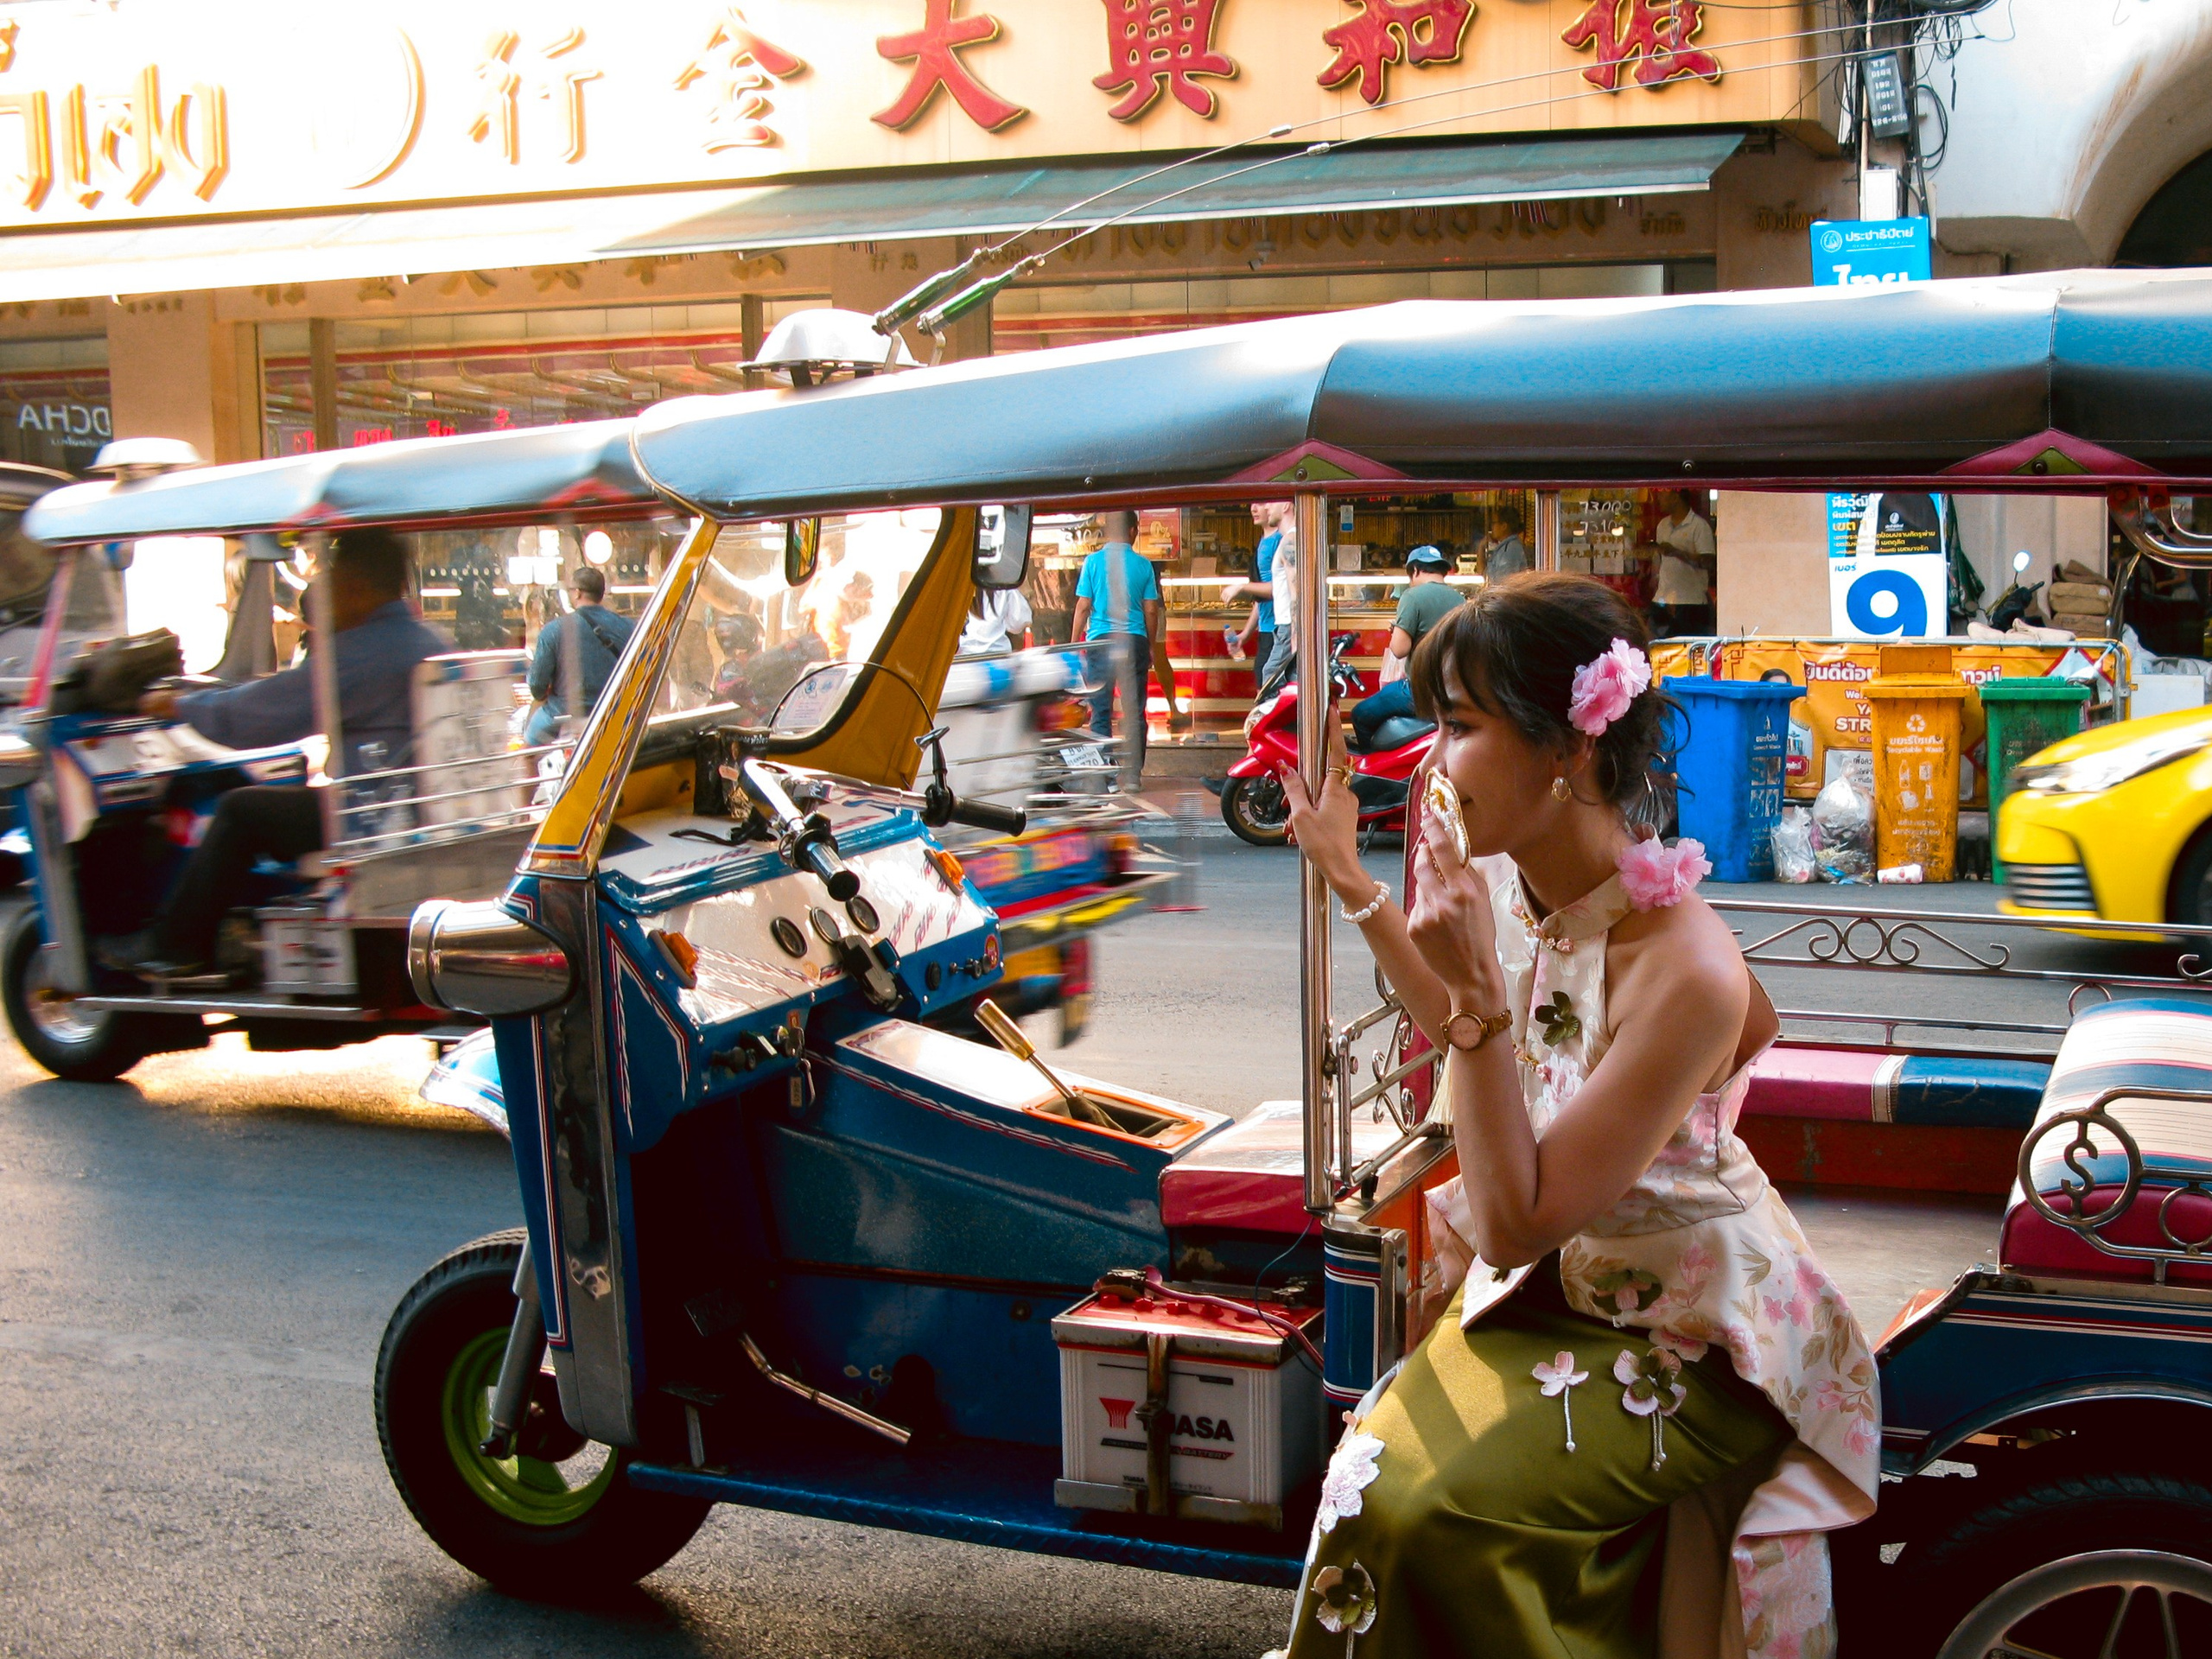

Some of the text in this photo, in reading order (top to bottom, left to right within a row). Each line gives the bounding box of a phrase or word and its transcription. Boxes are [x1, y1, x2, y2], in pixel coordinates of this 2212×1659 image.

[1845, 226, 1915, 243] ประชาธิปัตย์
[1834, 562, 1857, 572] เบอร์
[1846, 569, 1928, 638] 9
[1845, 690, 1869, 700] We
[1141, 1413, 1235, 1441] ASA
